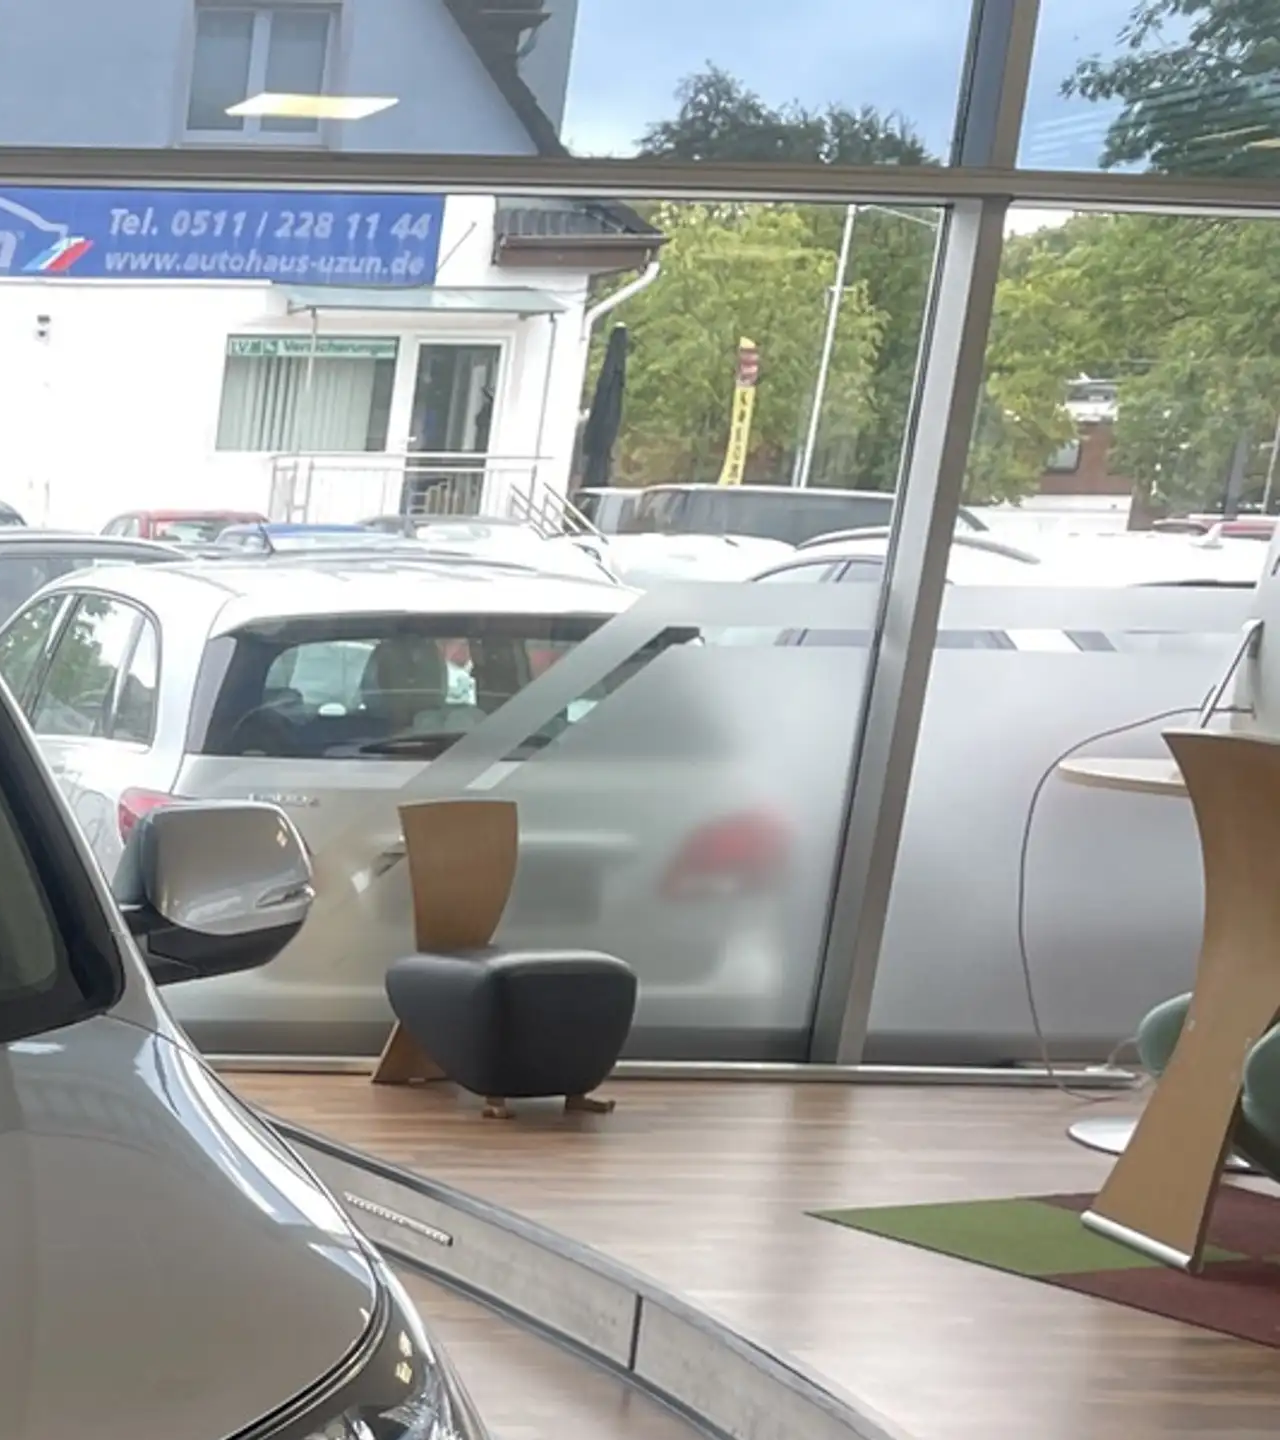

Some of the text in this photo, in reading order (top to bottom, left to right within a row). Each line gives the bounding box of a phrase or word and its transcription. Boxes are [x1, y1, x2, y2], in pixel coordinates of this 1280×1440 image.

[108, 206, 159, 237] Tel.
[170, 208, 246, 238] 0511
[274, 210, 336, 239] 228
[346, 212, 380, 241] 11
[390, 212, 433, 241] 44
[104, 248, 426, 277] www.autohaus-uzun.de
